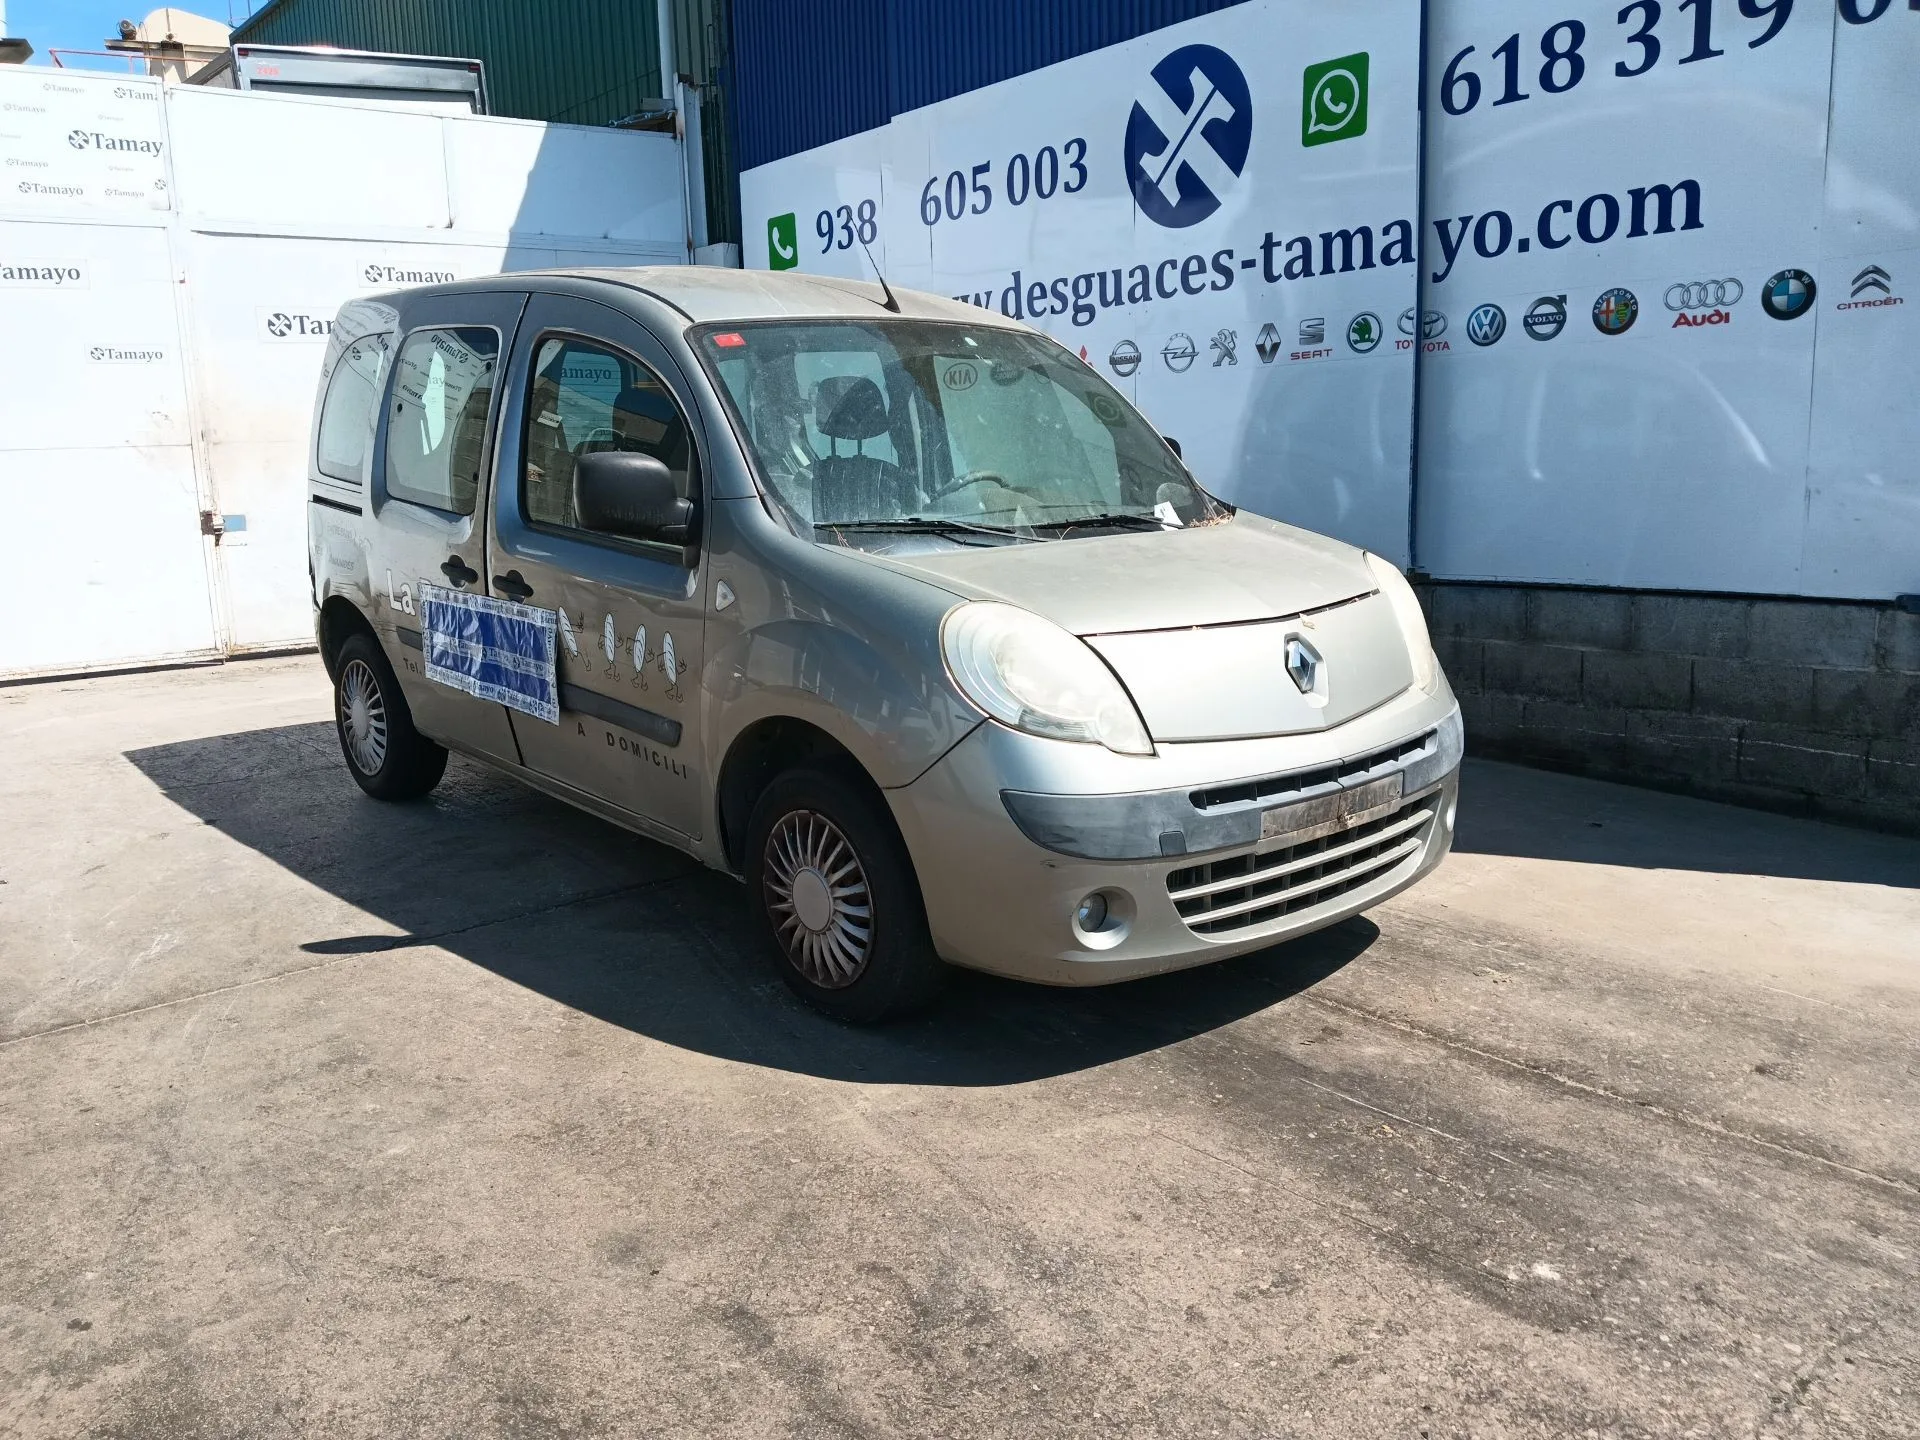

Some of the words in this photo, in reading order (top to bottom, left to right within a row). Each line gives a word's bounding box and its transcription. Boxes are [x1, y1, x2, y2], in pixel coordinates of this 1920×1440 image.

[1440, 19, 1586, 116] 618
[1614, 0, 1794, 78] 319
[31, 183, 84, 198] Tamayo
[113, 189, 145, 198] Tamayo
[815, 198, 878, 254] 938
[920, 161, 993, 226] 605
[1006, 137, 1089, 207] 003
[0, 263, 81, 285] amayo
[1767, 269, 1811, 288] BMW
[1526, 313, 1564, 325] VOLVO
[1671, 310, 1731, 329] Audi
[105, 348, 163, 362] Tamayo
[1109, 355, 1141, 366] NISSAN
[1290, 348, 1333, 361] SEAT
[948, 367, 972, 387] KIA
[386, 568, 417, 617] La
[403, 657, 422, 676] Tel.
[577, 721, 586, 737] A
[606, 731, 687, 780] DOMICILI
